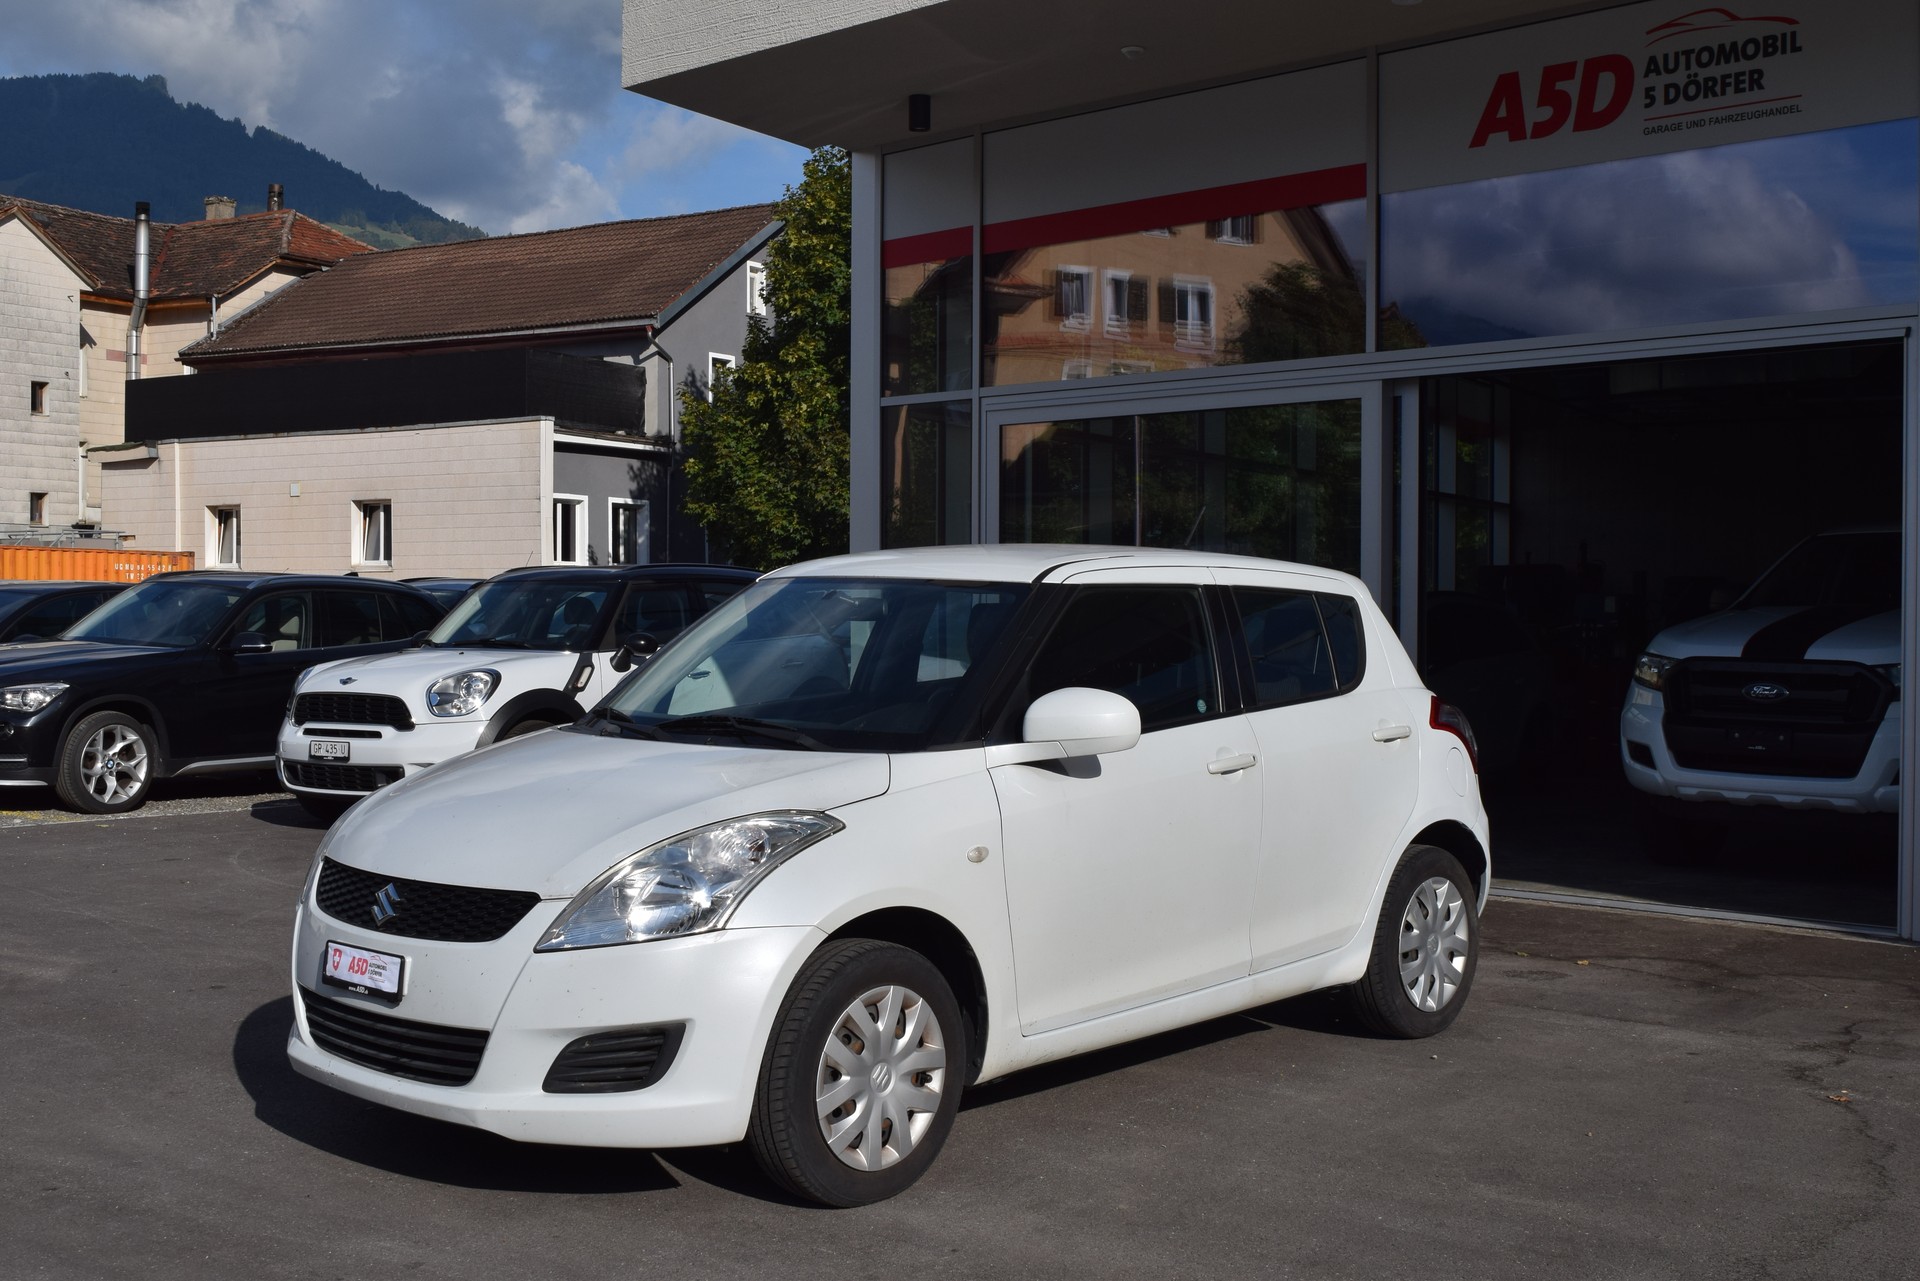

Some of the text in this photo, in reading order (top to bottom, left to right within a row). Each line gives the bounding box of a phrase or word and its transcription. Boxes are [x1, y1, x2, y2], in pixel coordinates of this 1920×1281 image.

[1643, 30, 1803, 79] AUTOMOBIL
[1469, 53, 1635, 149] A5D
[1644, 68, 1766, 109] 5 DÖRFER
[1643, 104, 1803, 136] GARAGE UND FAHRZEUGHANDEL
